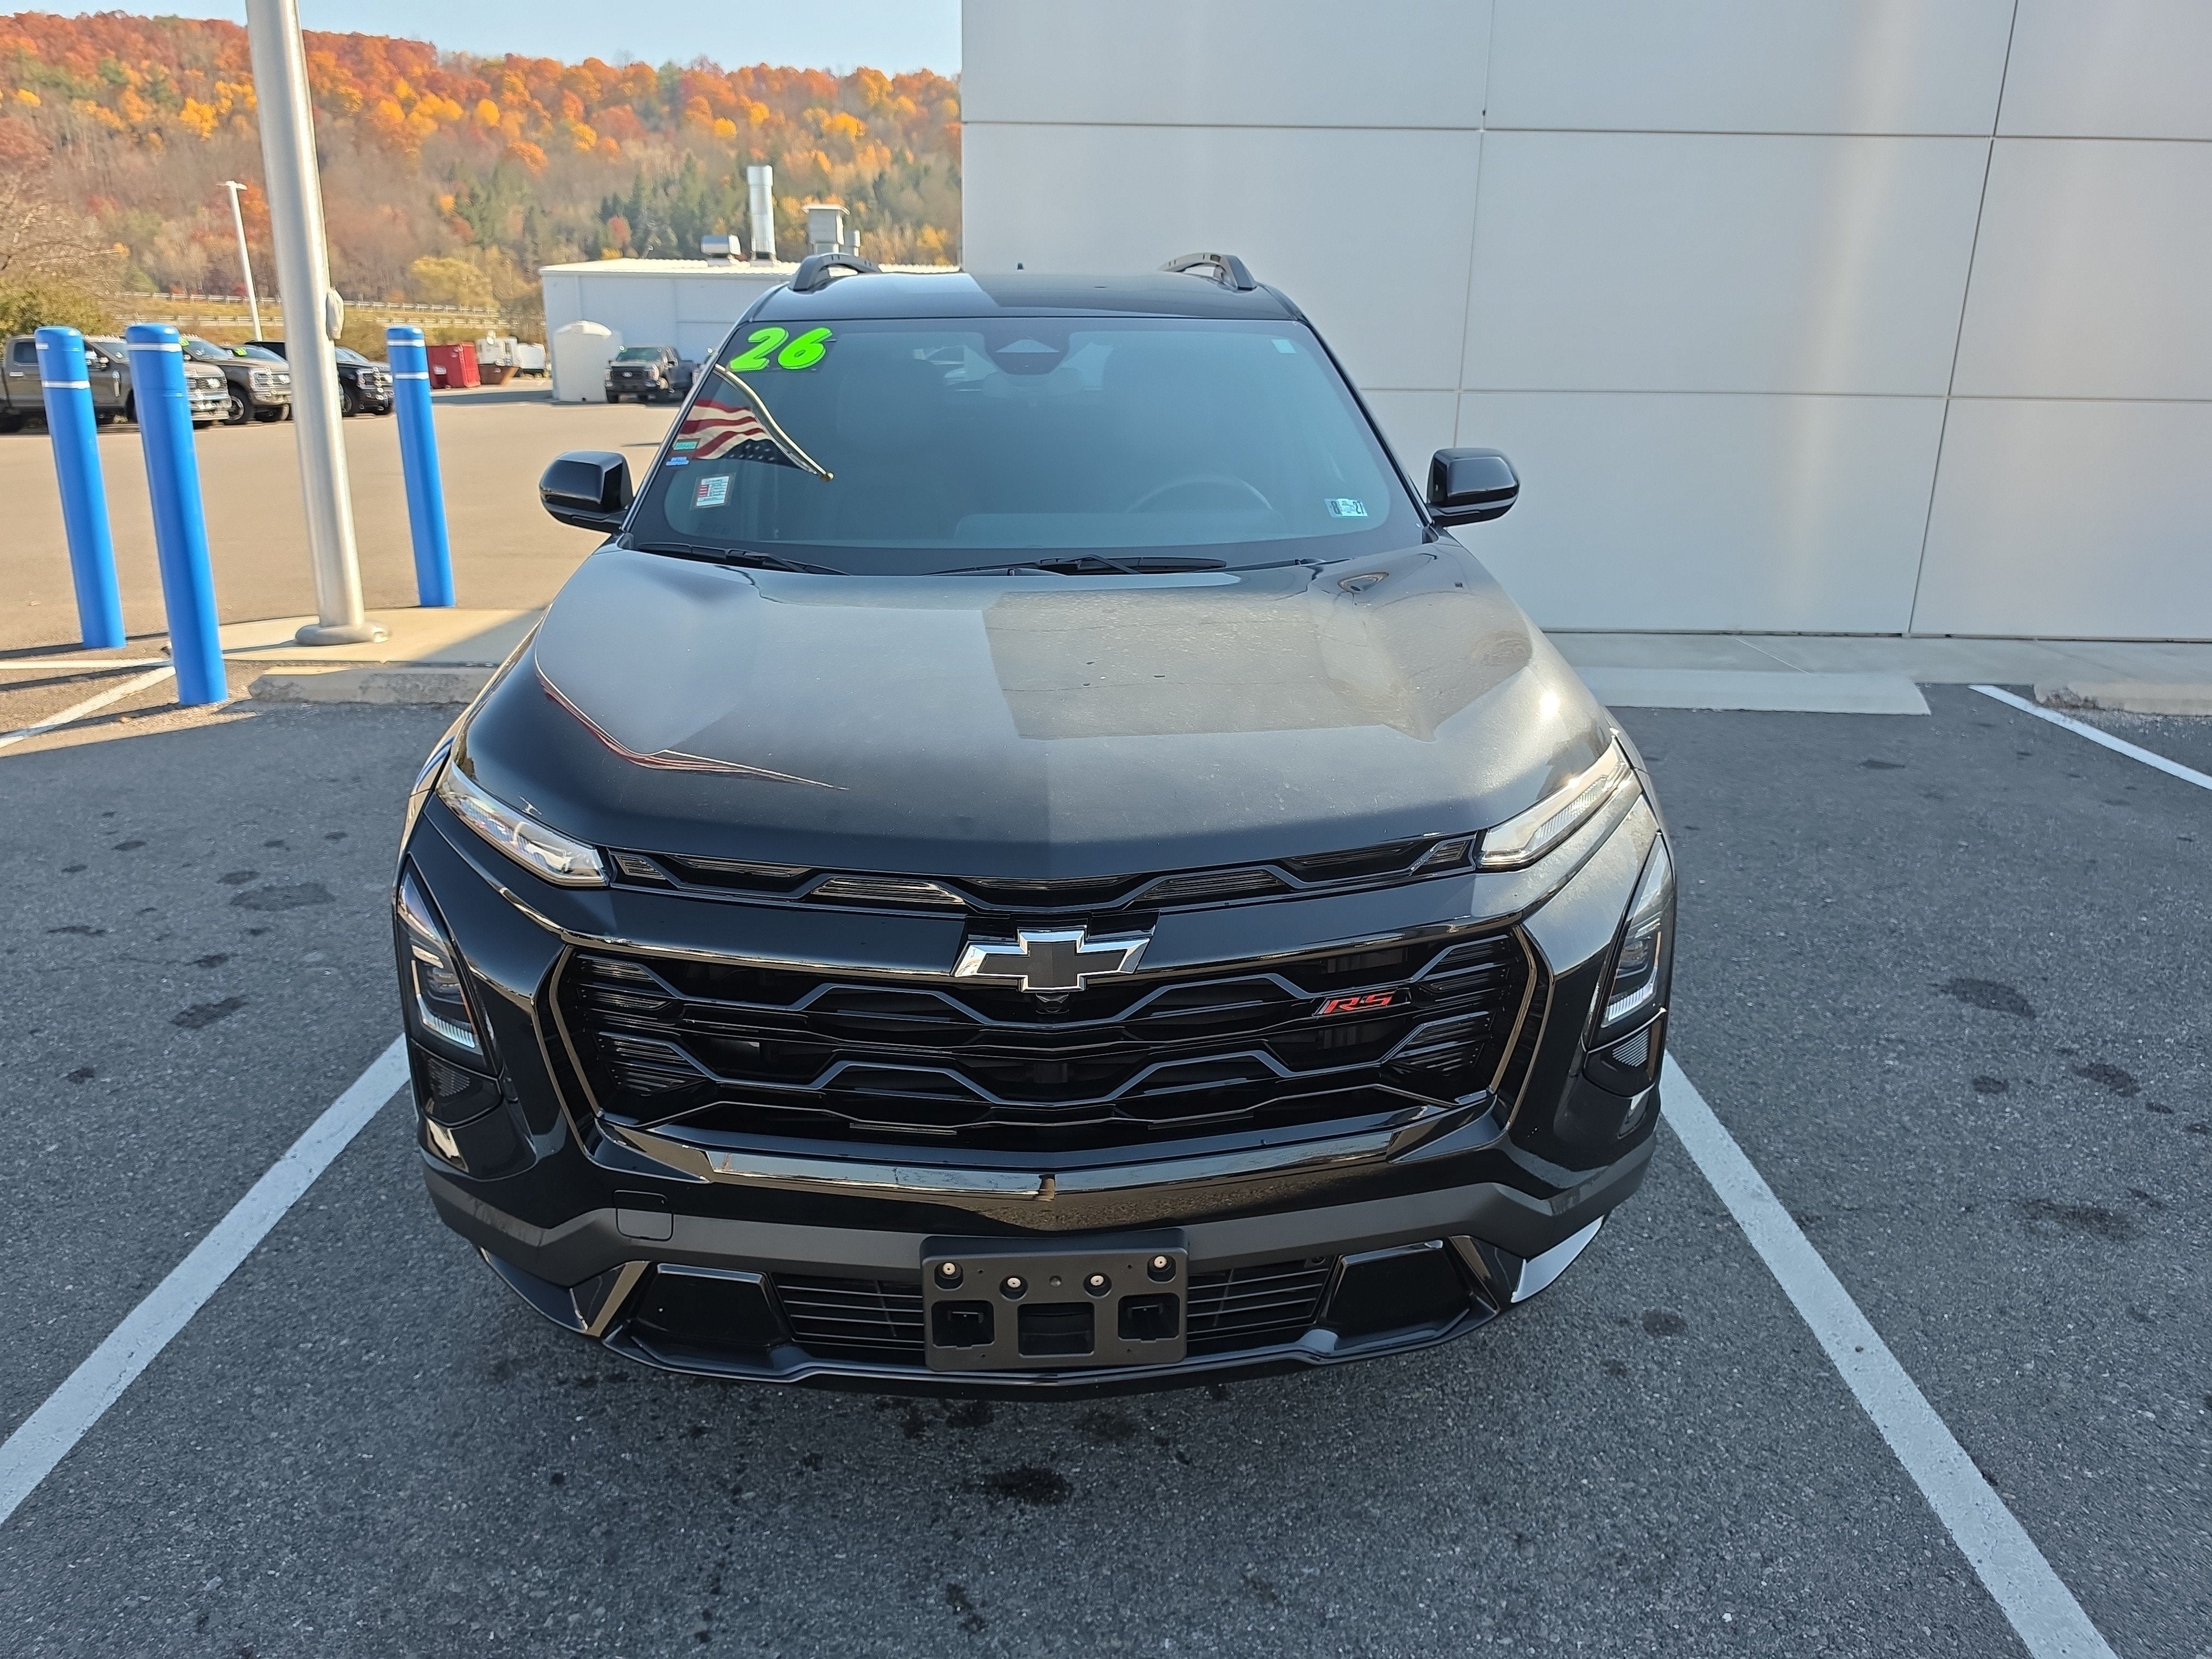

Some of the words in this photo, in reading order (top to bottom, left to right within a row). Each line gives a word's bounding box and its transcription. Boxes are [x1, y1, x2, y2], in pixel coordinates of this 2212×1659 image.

[730, 327, 833, 372] 26
[1352, 501, 1364, 516] 27
[1319, 991, 1396, 1014] RS
